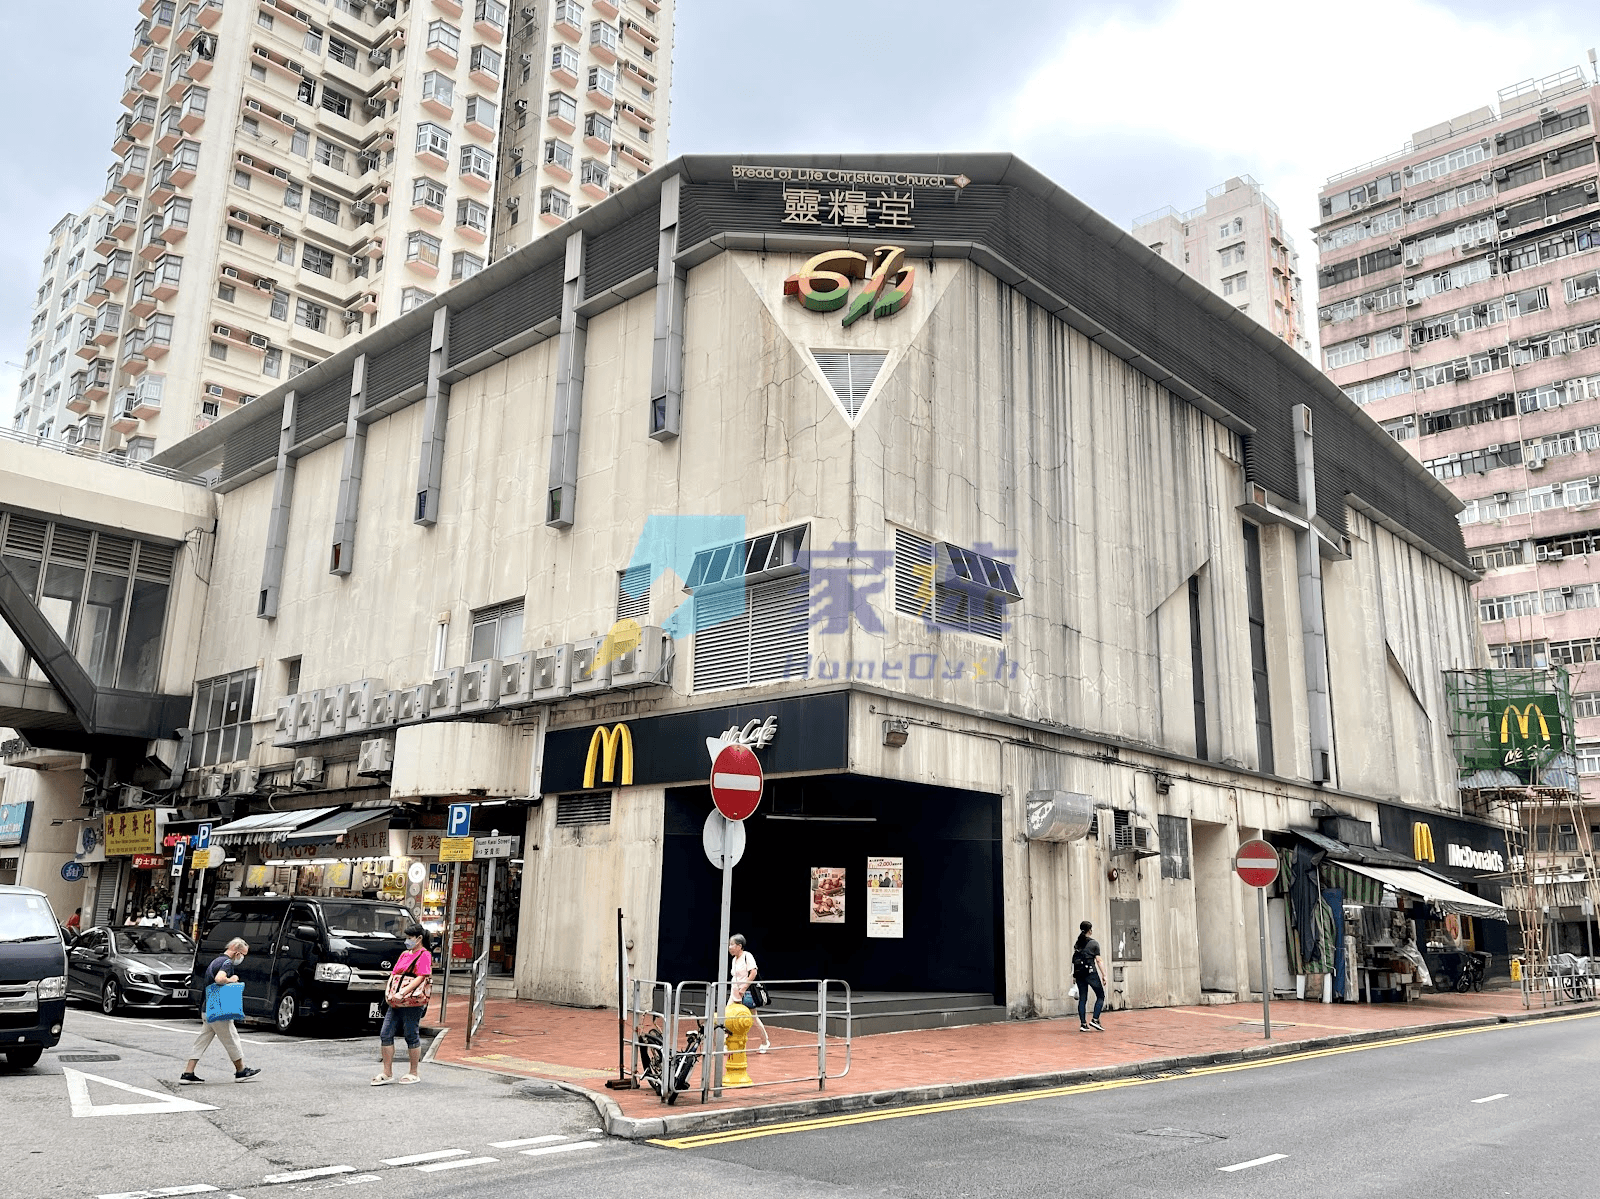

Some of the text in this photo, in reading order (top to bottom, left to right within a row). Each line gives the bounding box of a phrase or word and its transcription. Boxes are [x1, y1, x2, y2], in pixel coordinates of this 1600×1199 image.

[732, 165, 774, 179] Bread
[827, 170, 891, 185] Christian
[895, 173, 946, 187] Church
[781, 188, 916, 229] 靈糧堂
[451, 807, 467, 834] P
[198, 826, 209, 848] P
[175, 844, 184, 864] P
[1448, 843, 1504, 873] McDonald's
